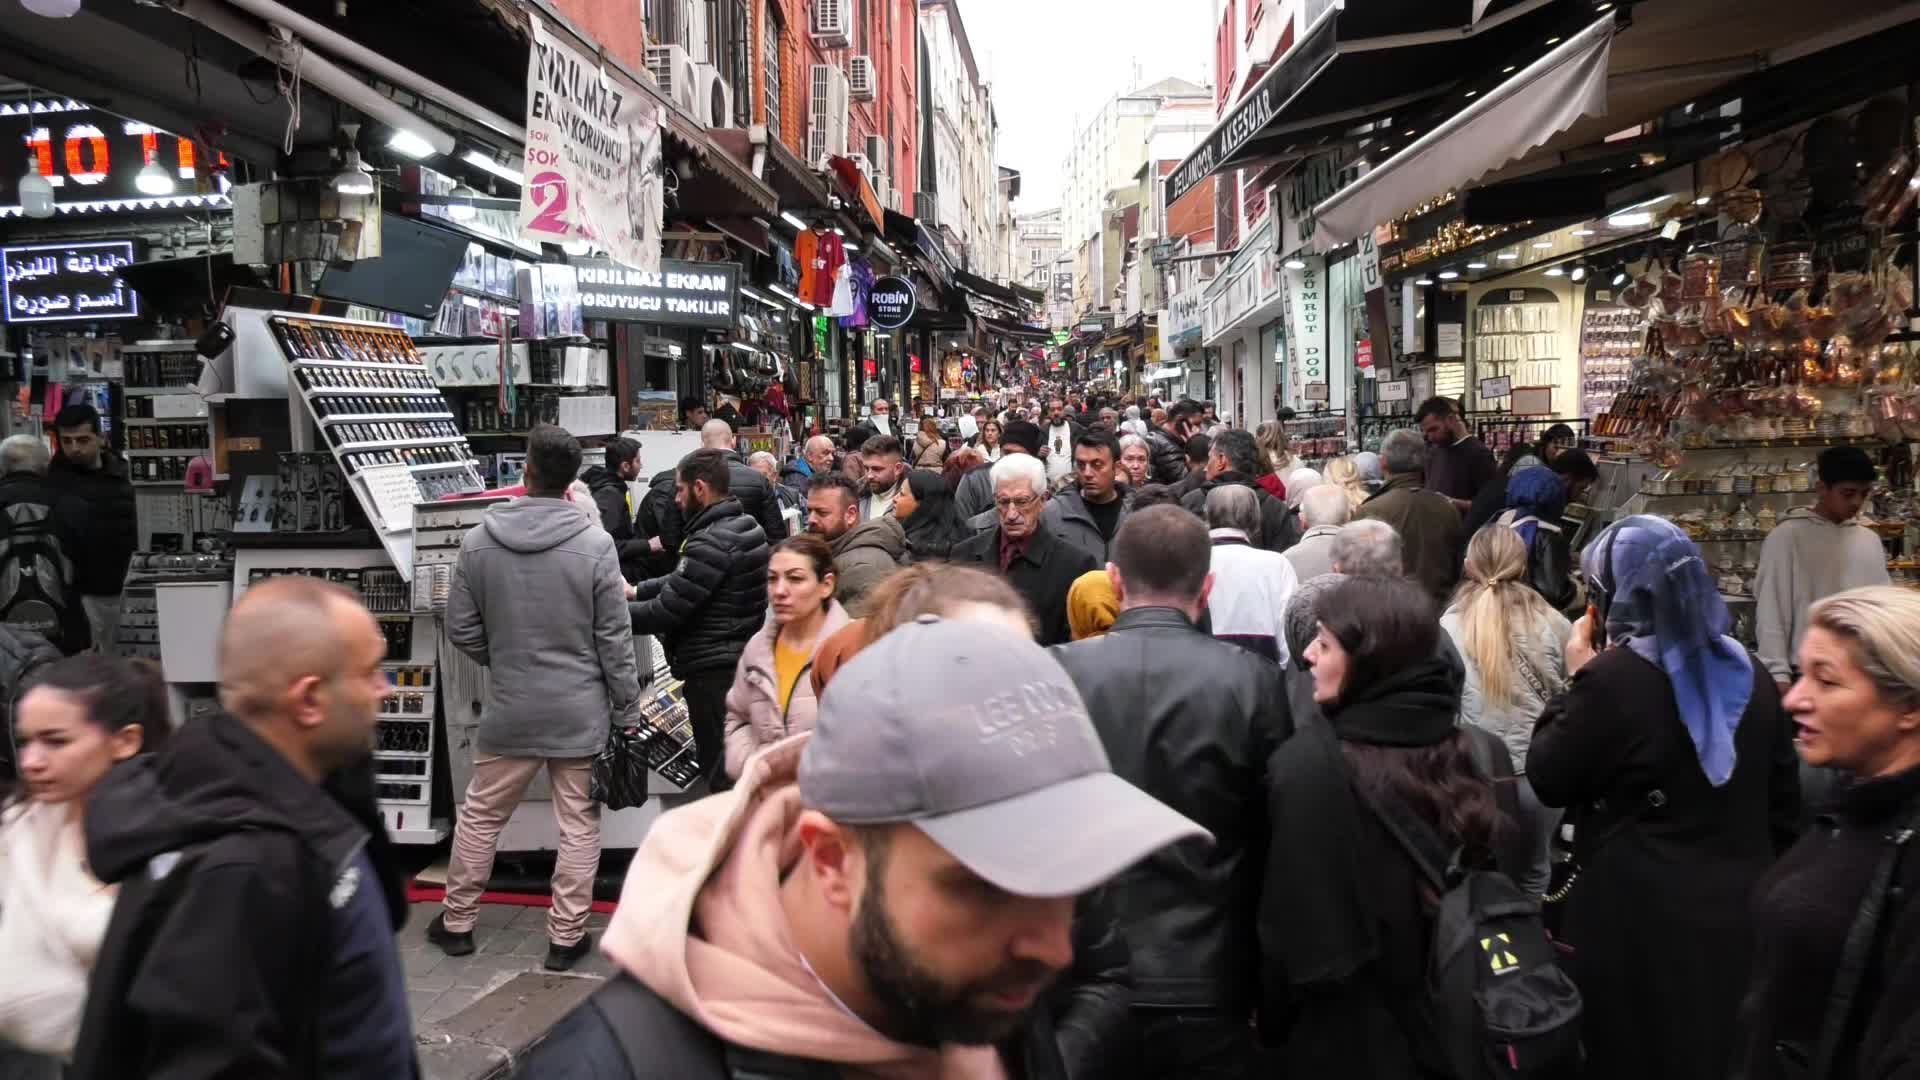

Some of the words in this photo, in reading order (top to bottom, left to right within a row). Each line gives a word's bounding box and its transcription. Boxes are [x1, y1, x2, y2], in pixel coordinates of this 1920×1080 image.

[1221, 88, 1273, 157] AKSESUAR
[527, 171, 569, 235] 2
[578, 267, 663, 288] KIRILMAZ
[666, 273, 727, 292] EKRAN
[665, 297, 730, 316] TAKILIR
[871, 290, 909, 305] ROBİN
[878, 305, 901, 313] STONE
